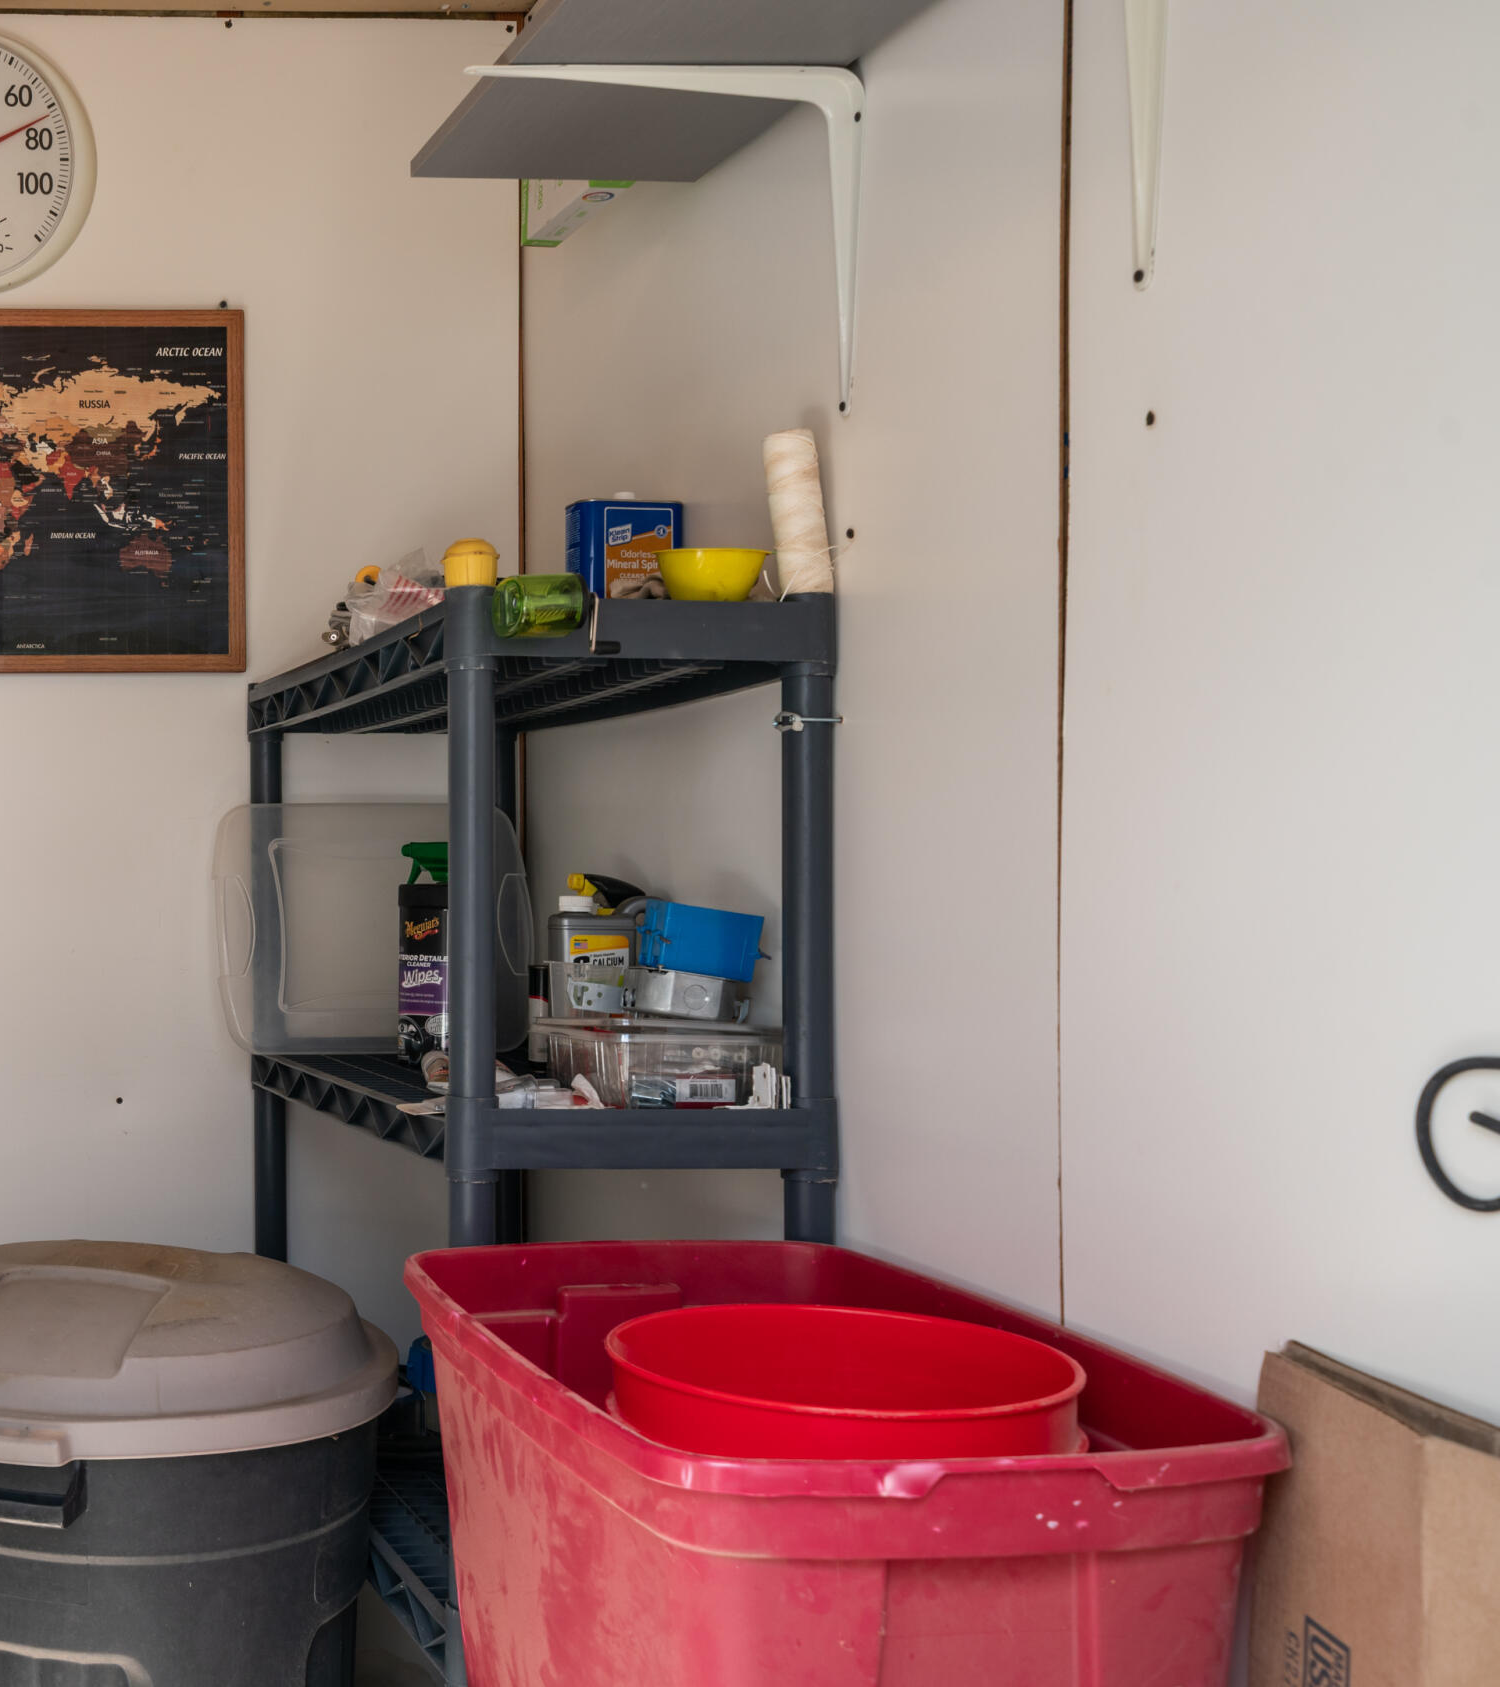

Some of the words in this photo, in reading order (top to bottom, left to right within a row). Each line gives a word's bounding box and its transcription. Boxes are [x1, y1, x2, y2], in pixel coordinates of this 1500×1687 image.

[4, 84, 33, 108] 60
[25, 128, 53, 150] 80
[17, 172, 54, 195] 100
[156, 347, 190, 357] ARCTIC
[192, 347, 223, 357] OCEAN
[79, 400, 110, 408] RUSSIA
[607, 559, 639, 569] Mineral
[641, 559, 658, 572] Spir
[593, 956, 624, 966] CALCIUM
[404, 968, 440, 984] Wipes
[1308, 1634, 1332, 1687] US
